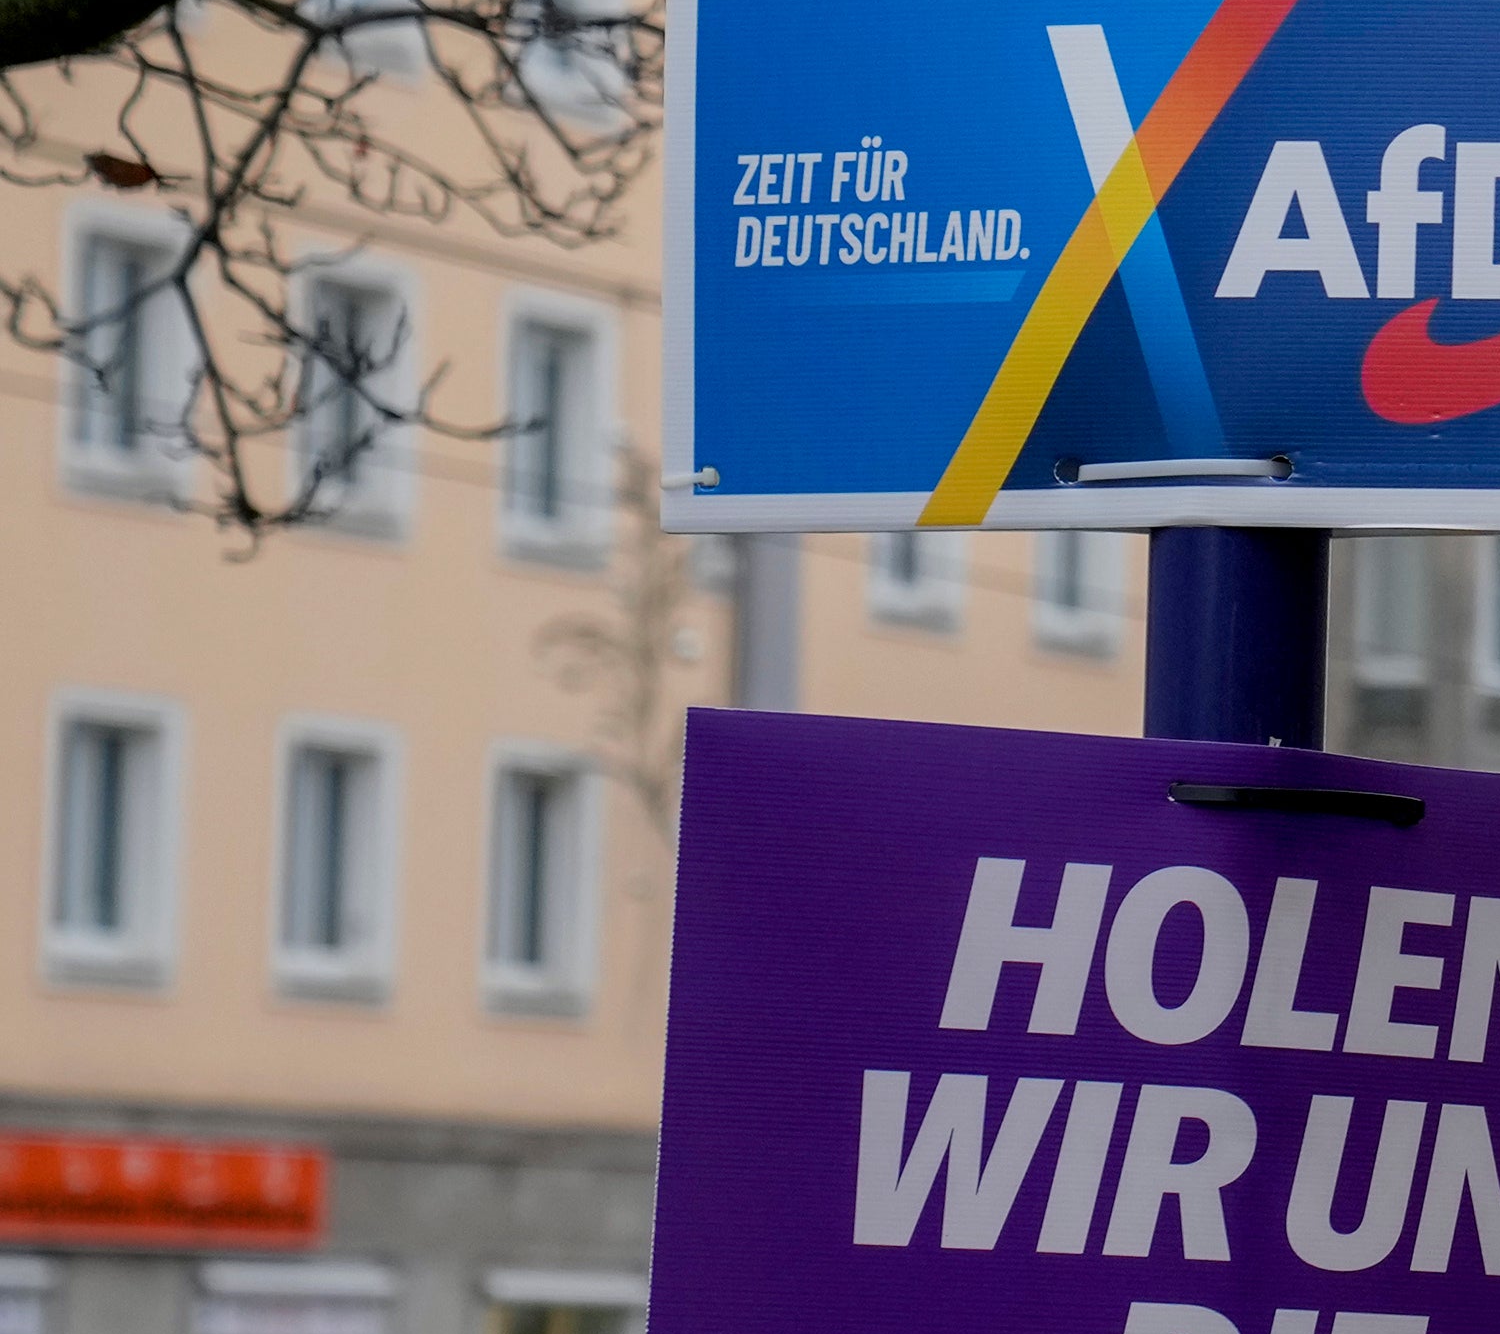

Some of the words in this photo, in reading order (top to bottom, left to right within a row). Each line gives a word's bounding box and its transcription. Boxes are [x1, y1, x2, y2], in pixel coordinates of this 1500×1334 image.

[734, 151, 822, 206] ZEIT
[831, 135, 909, 203] FÜR
[735, 207, 1032, 268] DEUTSCHLAND.
[852, 1069, 1258, 1262] WIR
